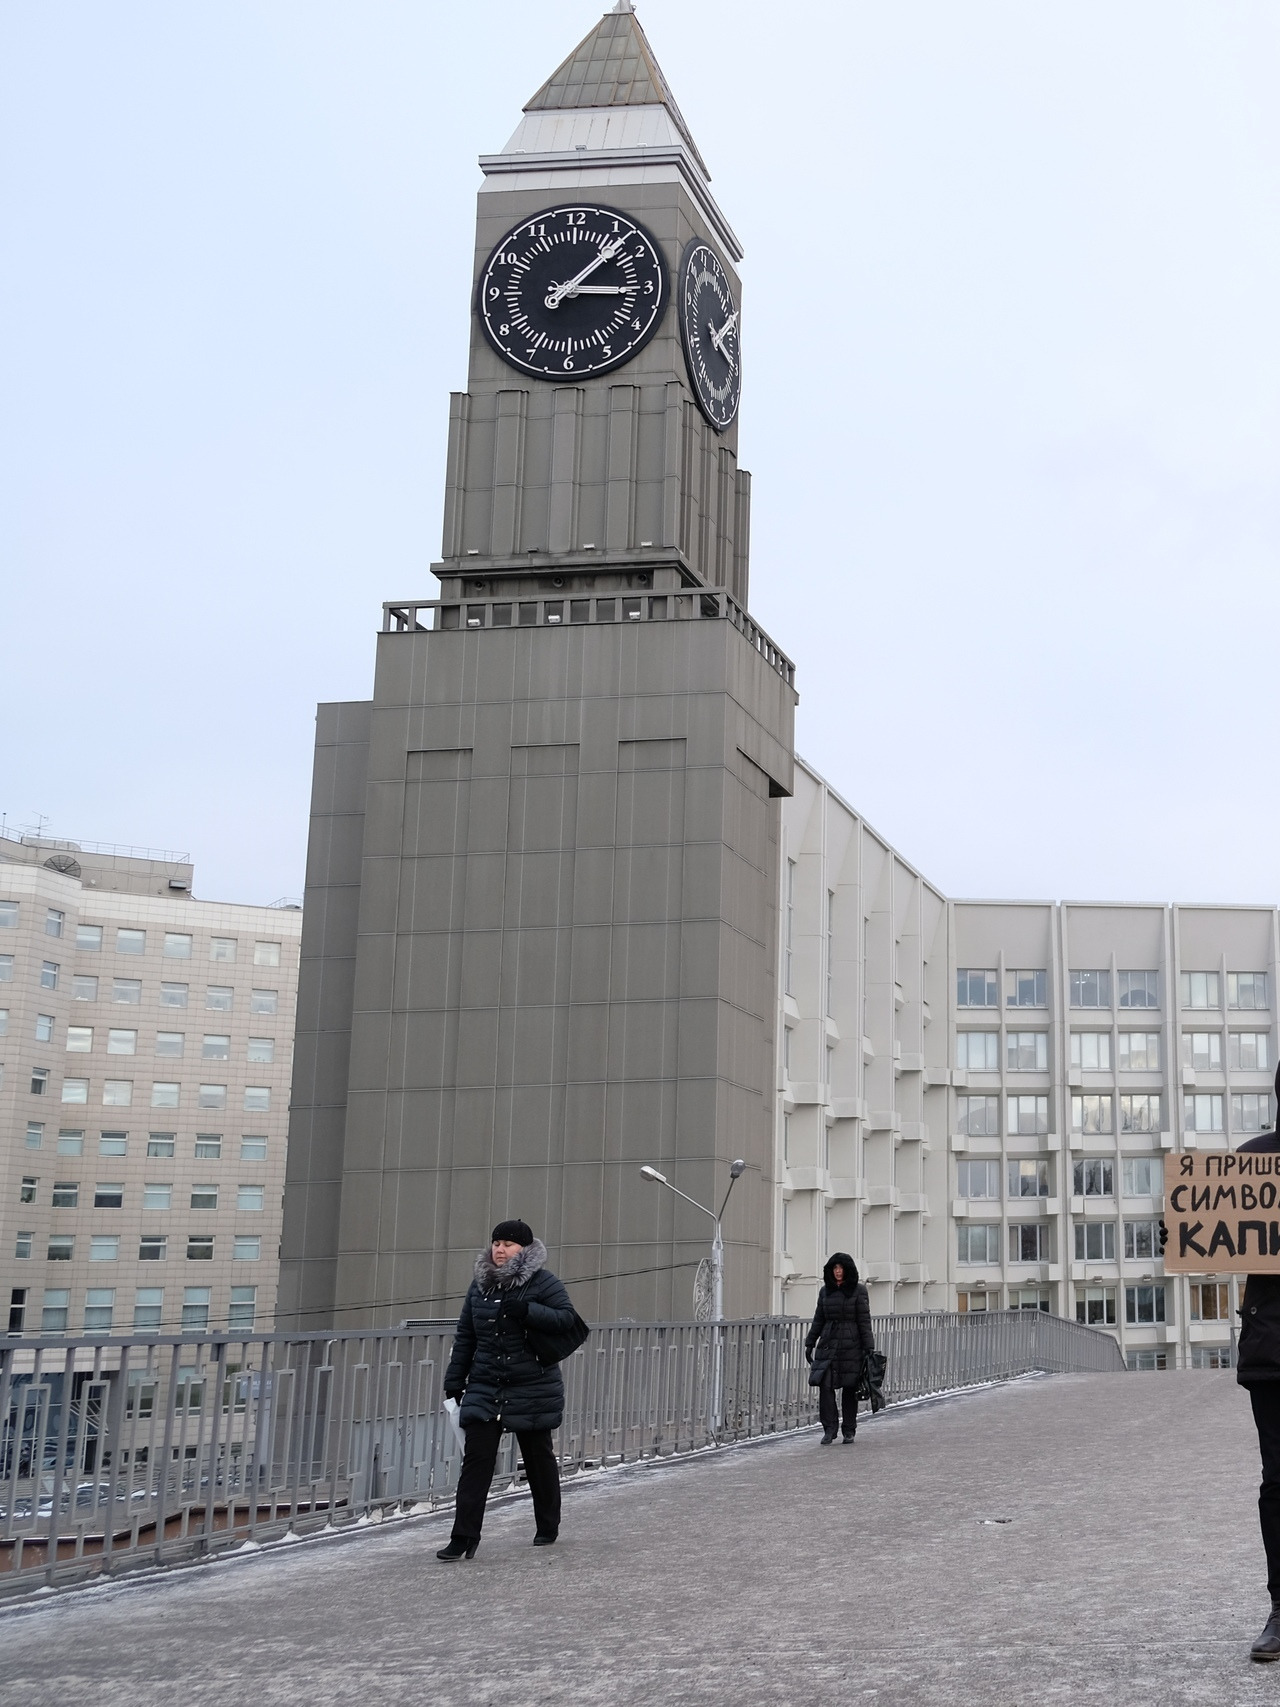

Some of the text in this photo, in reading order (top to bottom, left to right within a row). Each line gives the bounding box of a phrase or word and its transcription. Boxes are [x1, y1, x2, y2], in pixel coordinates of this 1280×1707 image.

[566, 212, 586, 225] 12
[528, 224, 547, 237] 11
[612, 220, 620, 233] 1
[498, 252, 517, 265] 10
[635, 245, 645, 258] 2
[489, 287, 500, 301] 9
[643, 280, 654, 295] 3
[687, 292, 692, 306] 9
[499, 324, 510, 336] 8
[631, 316, 642, 331] 4
[526, 349, 536, 361] 7
[602, 345, 612, 359] 5
[563, 355, 574, 370] 6
[734, 363, 739, 377] 3
[1179, 1155, 1194, 1177] Я
